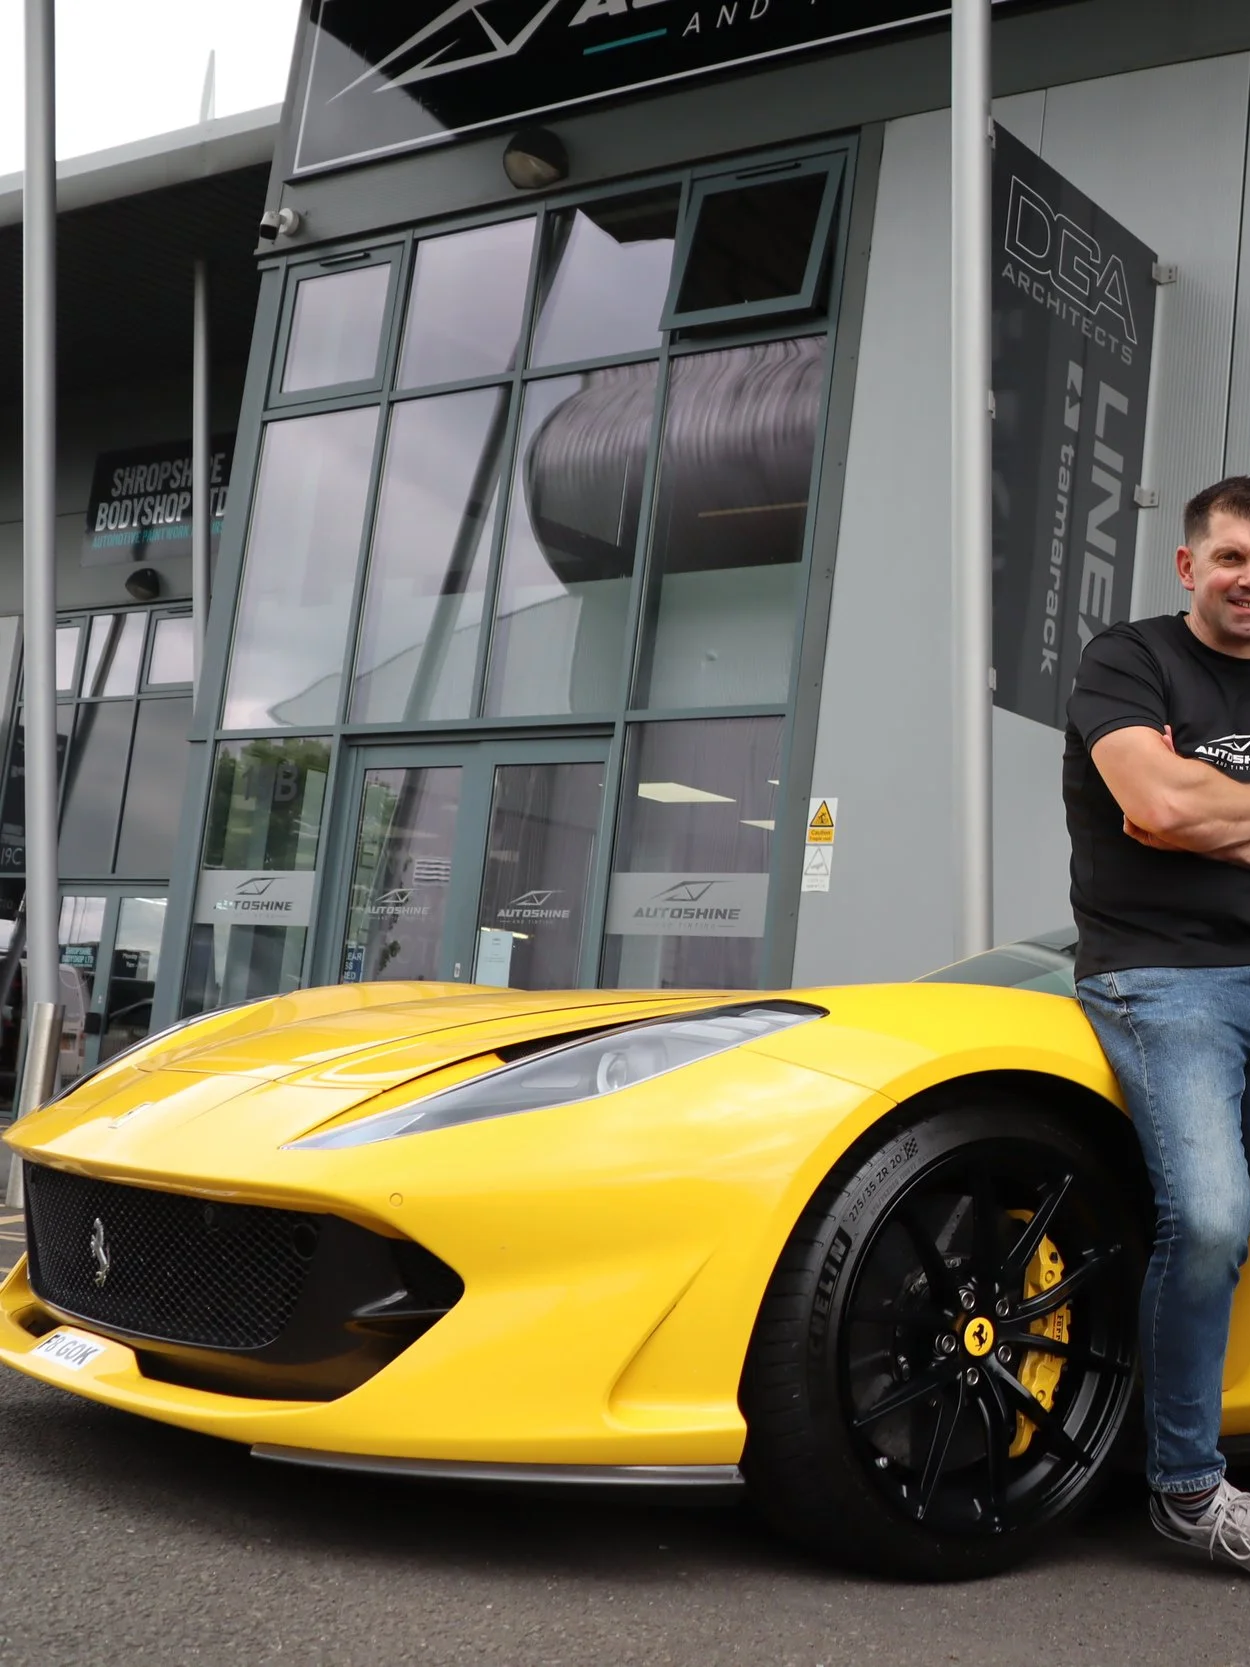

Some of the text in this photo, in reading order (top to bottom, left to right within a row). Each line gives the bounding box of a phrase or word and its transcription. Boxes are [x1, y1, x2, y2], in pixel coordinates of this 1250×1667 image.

[682, 0, 769, 37] AND
[1002, 263, 1132, 365] ARCHITECTS
[111, 453, 226, 497] SHROPSHE
[95, 486, 229, 532] BODYSHOP TD
[1040, 443, 1074, 676] tamarack
[365, 906, 430, 915] AUTOSHINE
[497, 909, 571, 919] AUTOSHINE
[633, 907, 741, 920] AUTOSHINE
[848, 1153, 902, 1222] 275/35 ZR 20
